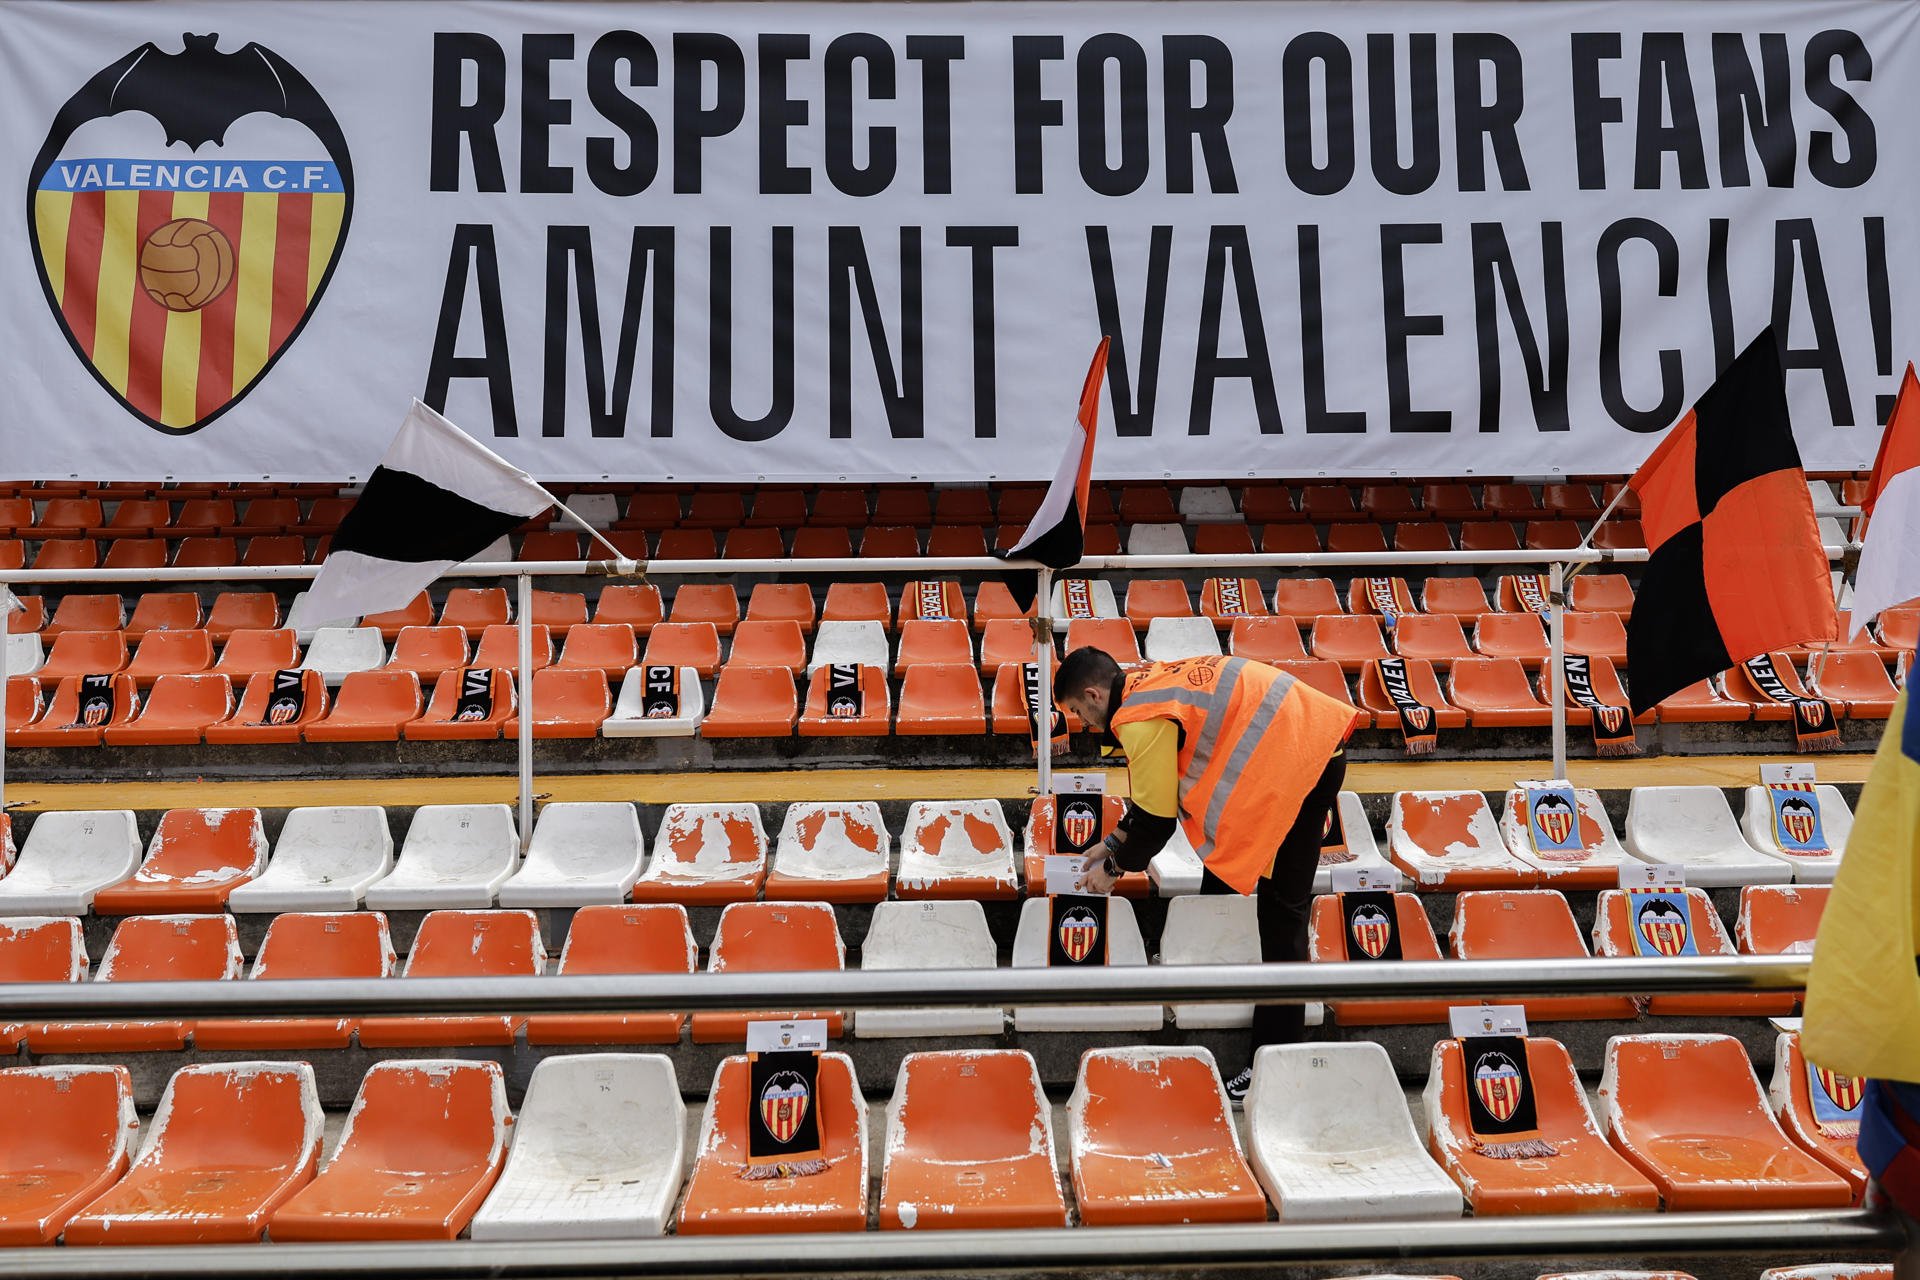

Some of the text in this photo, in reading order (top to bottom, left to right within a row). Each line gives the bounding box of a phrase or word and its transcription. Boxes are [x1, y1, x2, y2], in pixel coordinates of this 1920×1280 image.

[61, 164, 330, 189] VALENCIA C.F.
[430, 29, 1878, 197] RESPECT FOR OUR FANS
[423, 217, 1896, 442] AMUNT VALENCIA!
